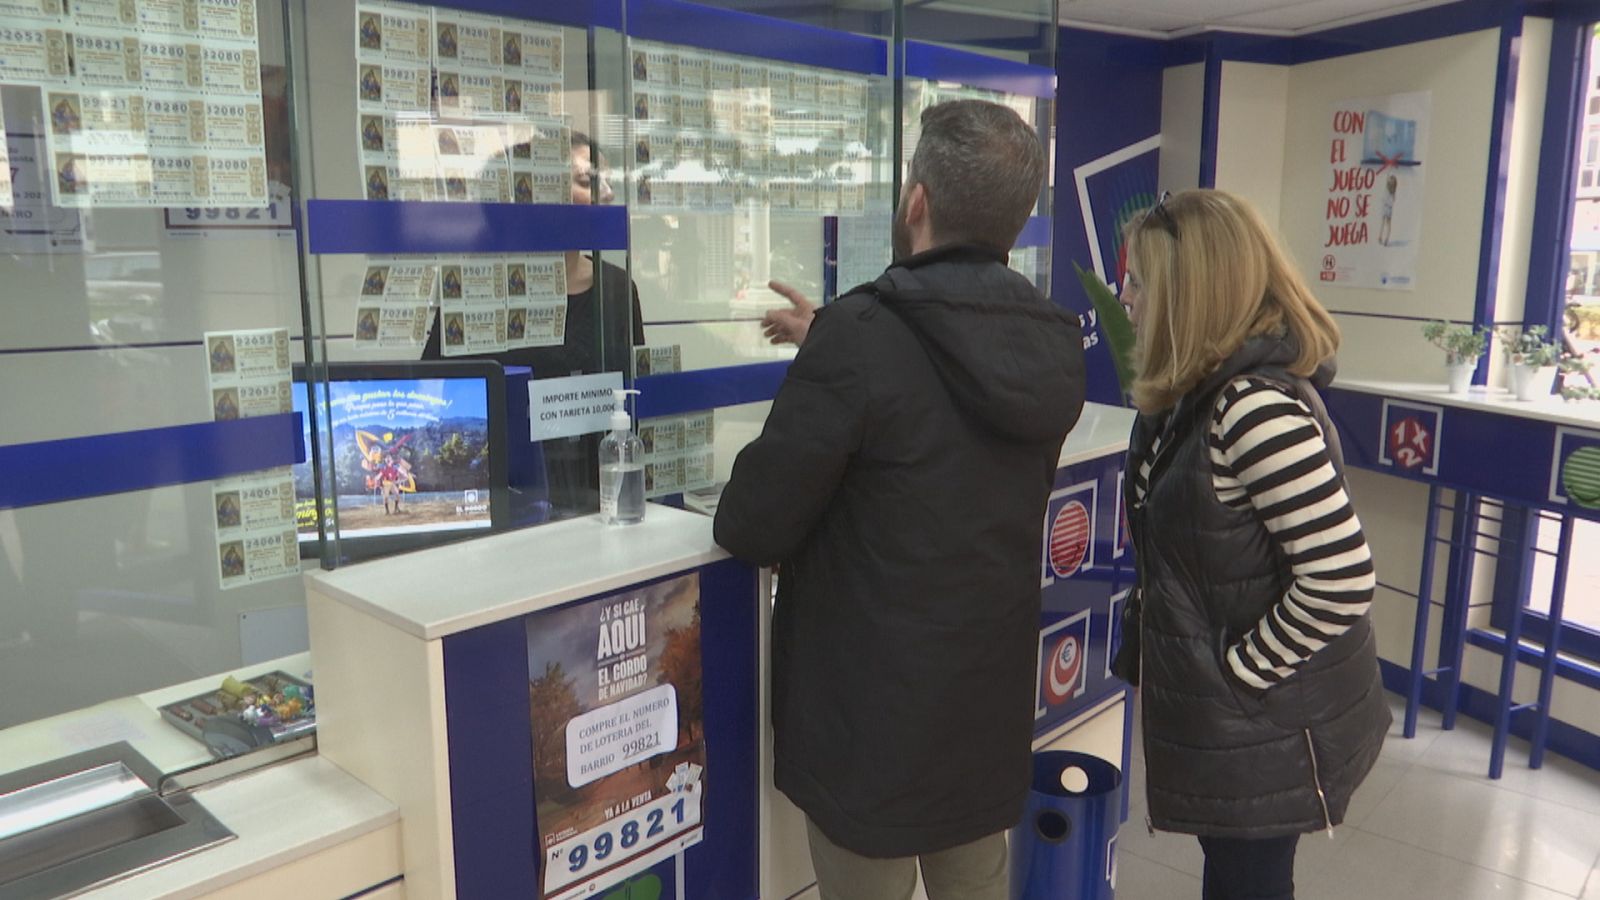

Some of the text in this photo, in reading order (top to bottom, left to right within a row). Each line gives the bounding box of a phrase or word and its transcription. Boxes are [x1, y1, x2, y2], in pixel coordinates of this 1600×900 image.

[142, 44, 184, 58] 78280
[1333, 110, 1365, 135] CON
[1330, 138, 1346, 164] EL
[1329, 166, 1376, 192] JUEGO
[1326, 194, 1371, 220] NO SE
[1324, 222, 1369, 248] JUEGA
[1088, 307, 1097, 327] y
[542, 387, 613, 404] IMPORTE MINIMO
[540, 410, 558, 421] CON
[559, 406, 591, 418] TARJETA
[613, 603, 623, 618] SI
[624, 598, 640, 616] CAE
[597, 605, 647, 661] AQUÍ
[598, 655, 648, 688] EL GORDO
[598, 685, 610, 702] DE
[579, 698, 670, 740] COMPRE EL NUMERO
[580, 718, 652, 755] DE LOTERIA DEL
[581, 731, 661, 775] BARRIO 99821
[605, 789, 652, 820] YA A LA VENTA
[568, 797, 685, 873] 99821
